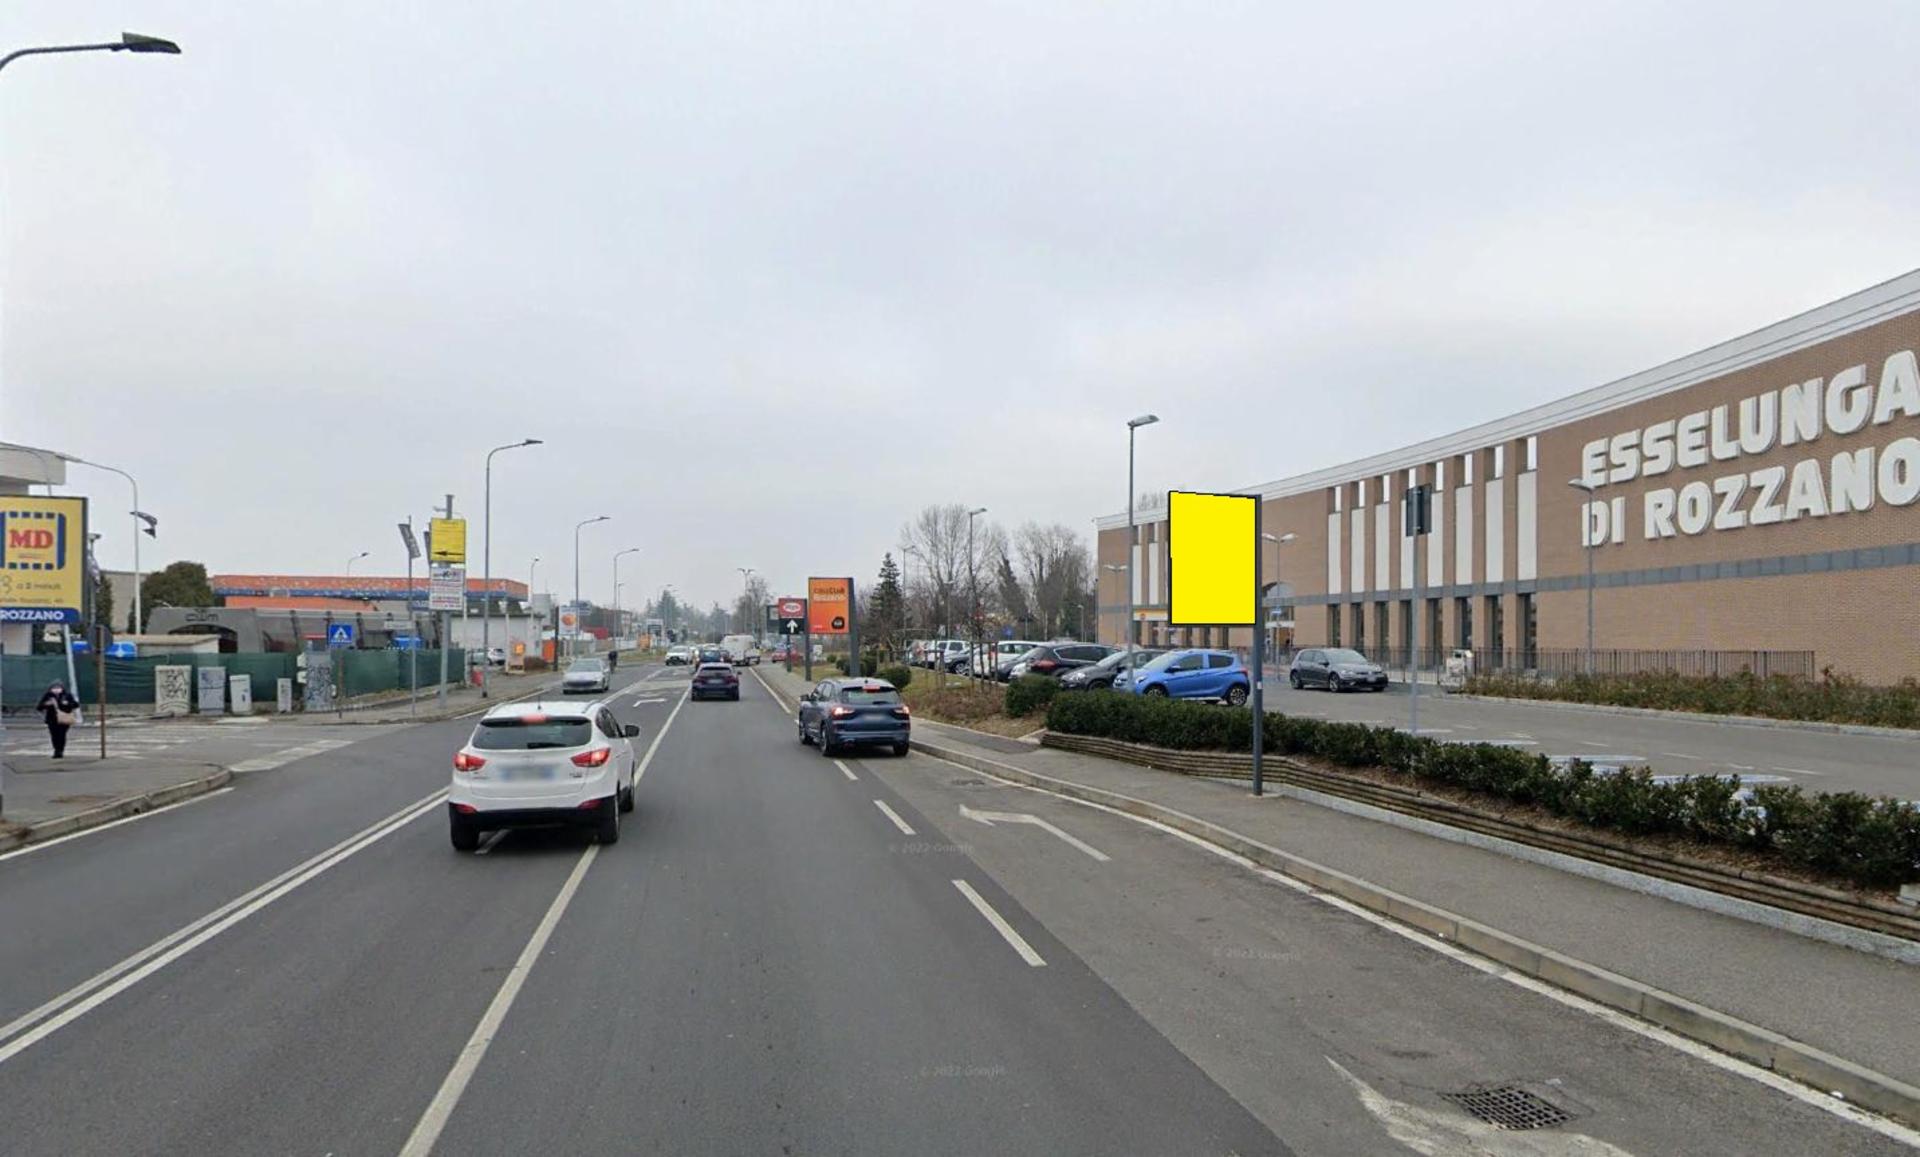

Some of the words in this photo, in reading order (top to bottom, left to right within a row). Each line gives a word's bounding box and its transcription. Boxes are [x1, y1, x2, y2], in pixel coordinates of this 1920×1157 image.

[1582, 350, 1920, 489] ESSELUNGA
[1582, 496, 1625, 547] DI
[1644, 437, 1920, 539] ROZZANO
[9, 529, 54, 549] MD
[0, 610, 65, 621] ROZZANO
